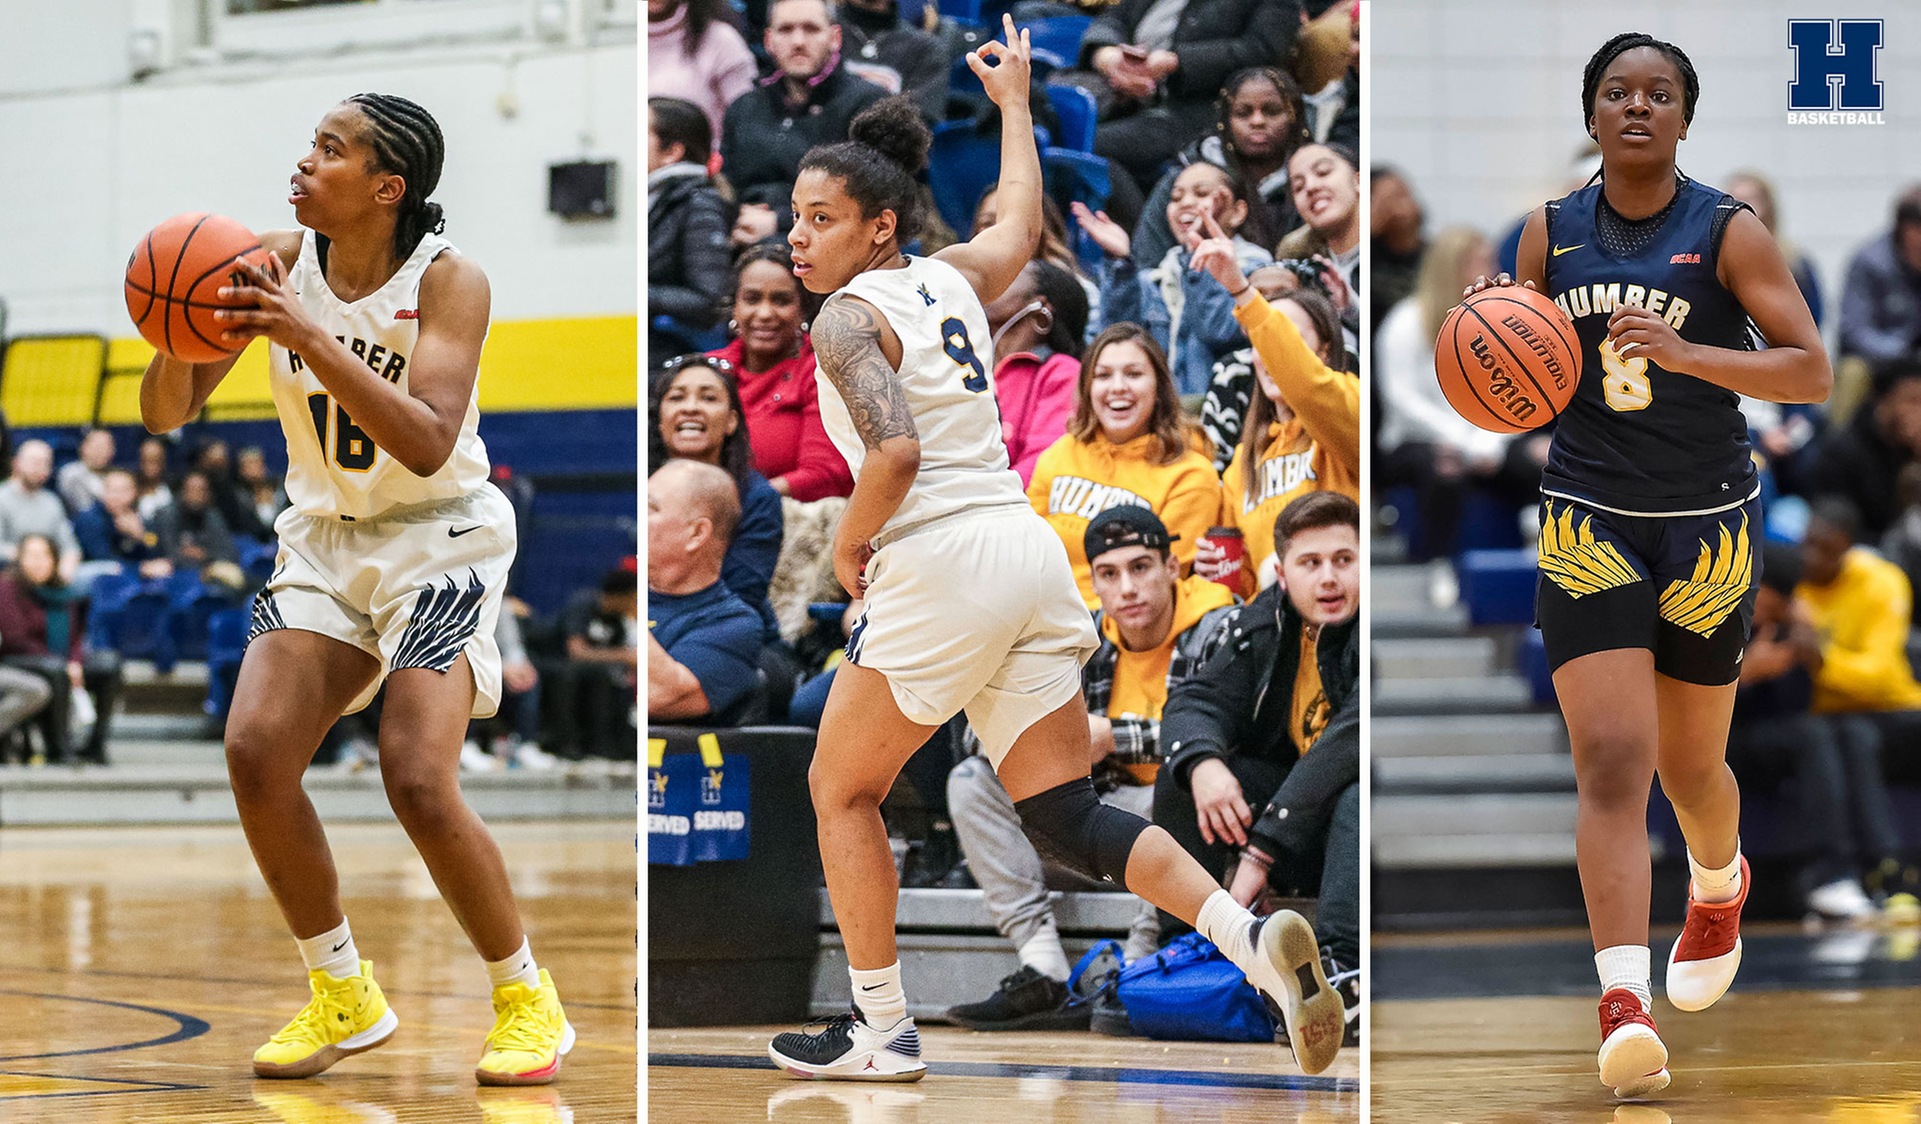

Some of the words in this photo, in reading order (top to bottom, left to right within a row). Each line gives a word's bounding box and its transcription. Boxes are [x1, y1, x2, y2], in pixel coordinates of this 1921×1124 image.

[1554, 282, 1691, 331] HUMBER
[287, 335, 407, 385] HBER
[940, 315, 990, 396] 9
[1469, 332, 1538, 423] Wilson
[1501, 315, 1569, 392] EVOLUTION
[1598, 332, 1653, 412] 8
